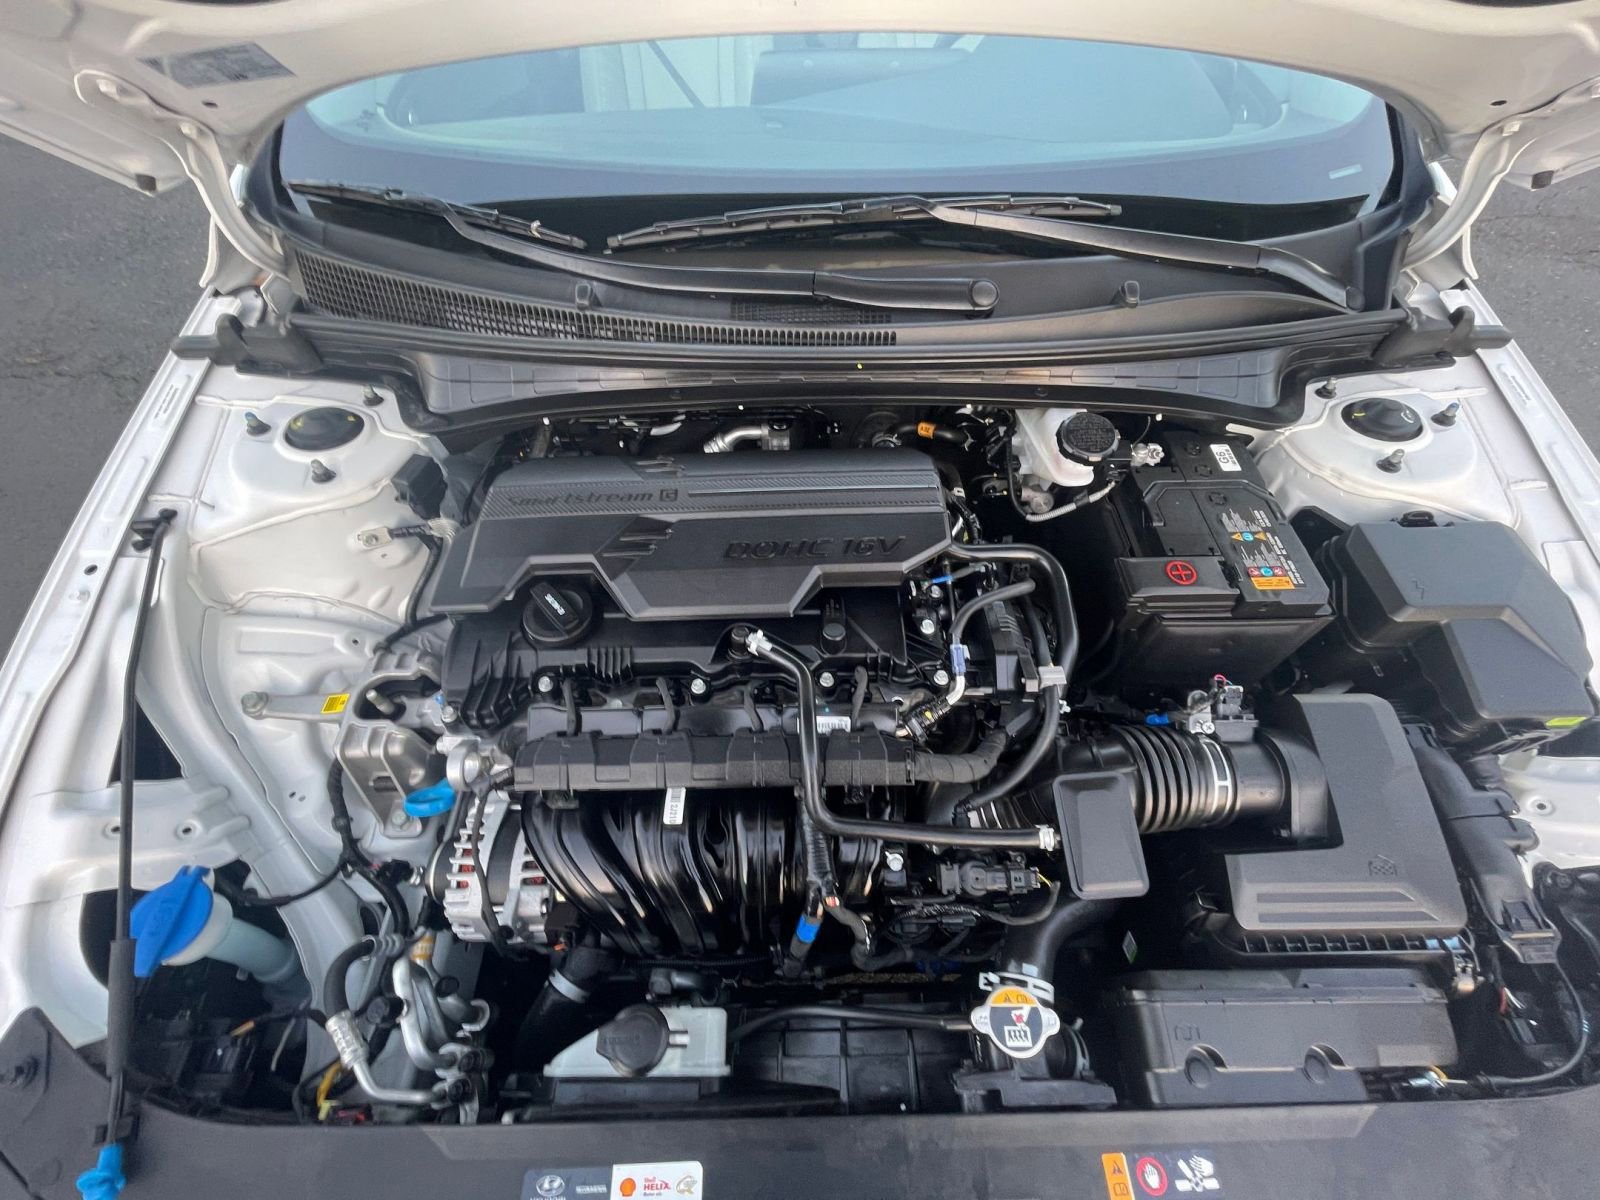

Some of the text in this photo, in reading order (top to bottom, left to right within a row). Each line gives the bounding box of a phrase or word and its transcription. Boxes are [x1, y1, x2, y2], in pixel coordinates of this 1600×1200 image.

[508, 492, 653, 506] Smartstream
[724, 536, 906, 559] DOHC 16V
[643, 1181, 671, 1191] HELIX
